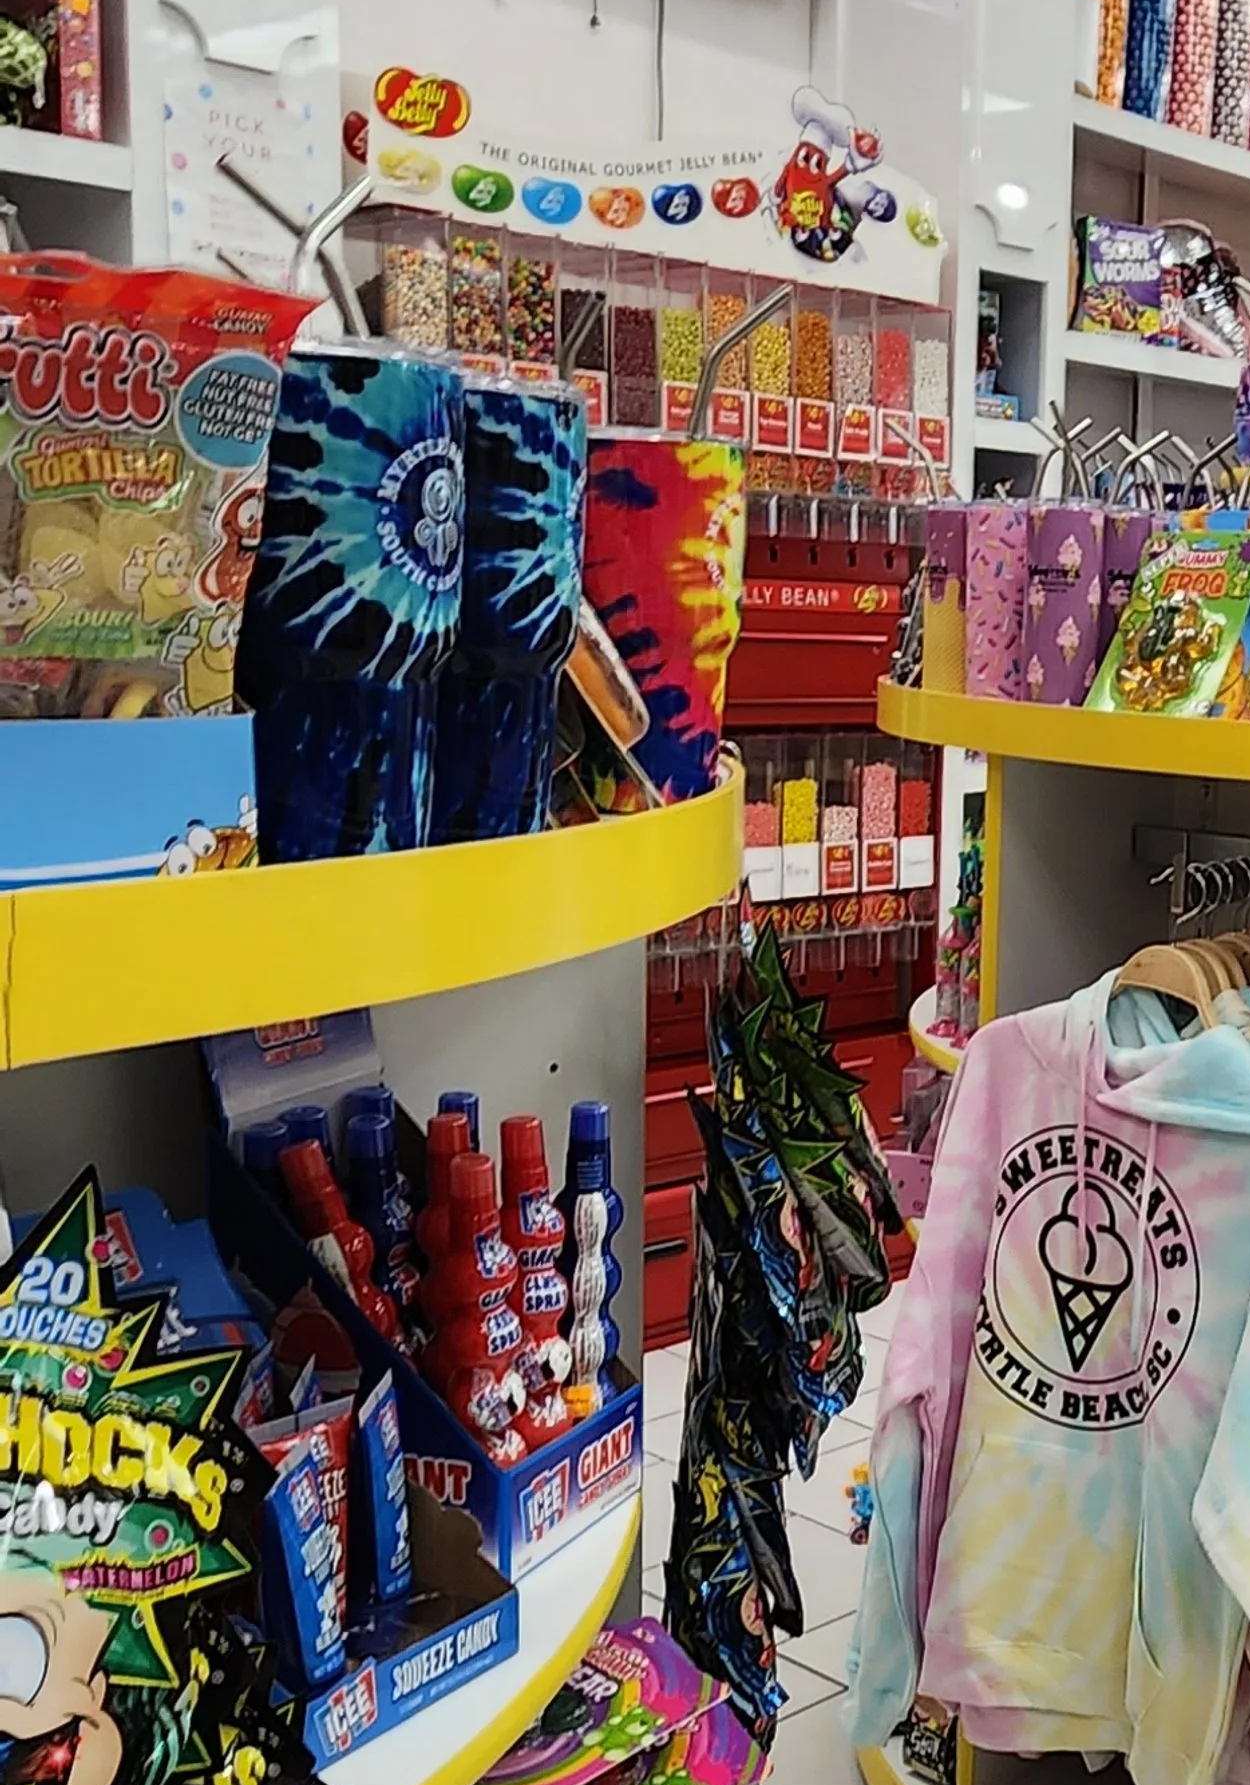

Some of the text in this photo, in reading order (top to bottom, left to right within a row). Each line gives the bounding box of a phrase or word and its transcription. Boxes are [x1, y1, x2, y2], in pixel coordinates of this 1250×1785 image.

[209, 109, 264, 135] PICK
[202, 133, 271, 161] YOUR
[480, 140, 510, 162] THE
[517, 152, 597, 176] ORIGINAL
[604, 158, 673, 177] GOURMET
[680, 154, 716, 173] JELLY
[1100, 240, 1151, 262] SOUR
[1094, 260, 1161, 284] WORMS
[209, 370, 239, 388] FAT
[21, 448, 176, 490] TORTILLA
[376, 520, 427, 586] SOUTH
[1177, 551, 1226, 567] GUMMY
[1161, 568, 1227, 598] FROG
[18, 1257, 85, 1307] 20
[1145, 1341, 1173, 1387] SC
[578, 1416, 633, 1489] GIANT
[404, 1454, 472, 1505] ANT
[527, 1477, 563, 1531] ICEE
[322, 1680, 372, 1744] ICEE
[391, 1634, 455, 1702] SQUEEZE
[456, 1609, 501, 1665] CANDY
